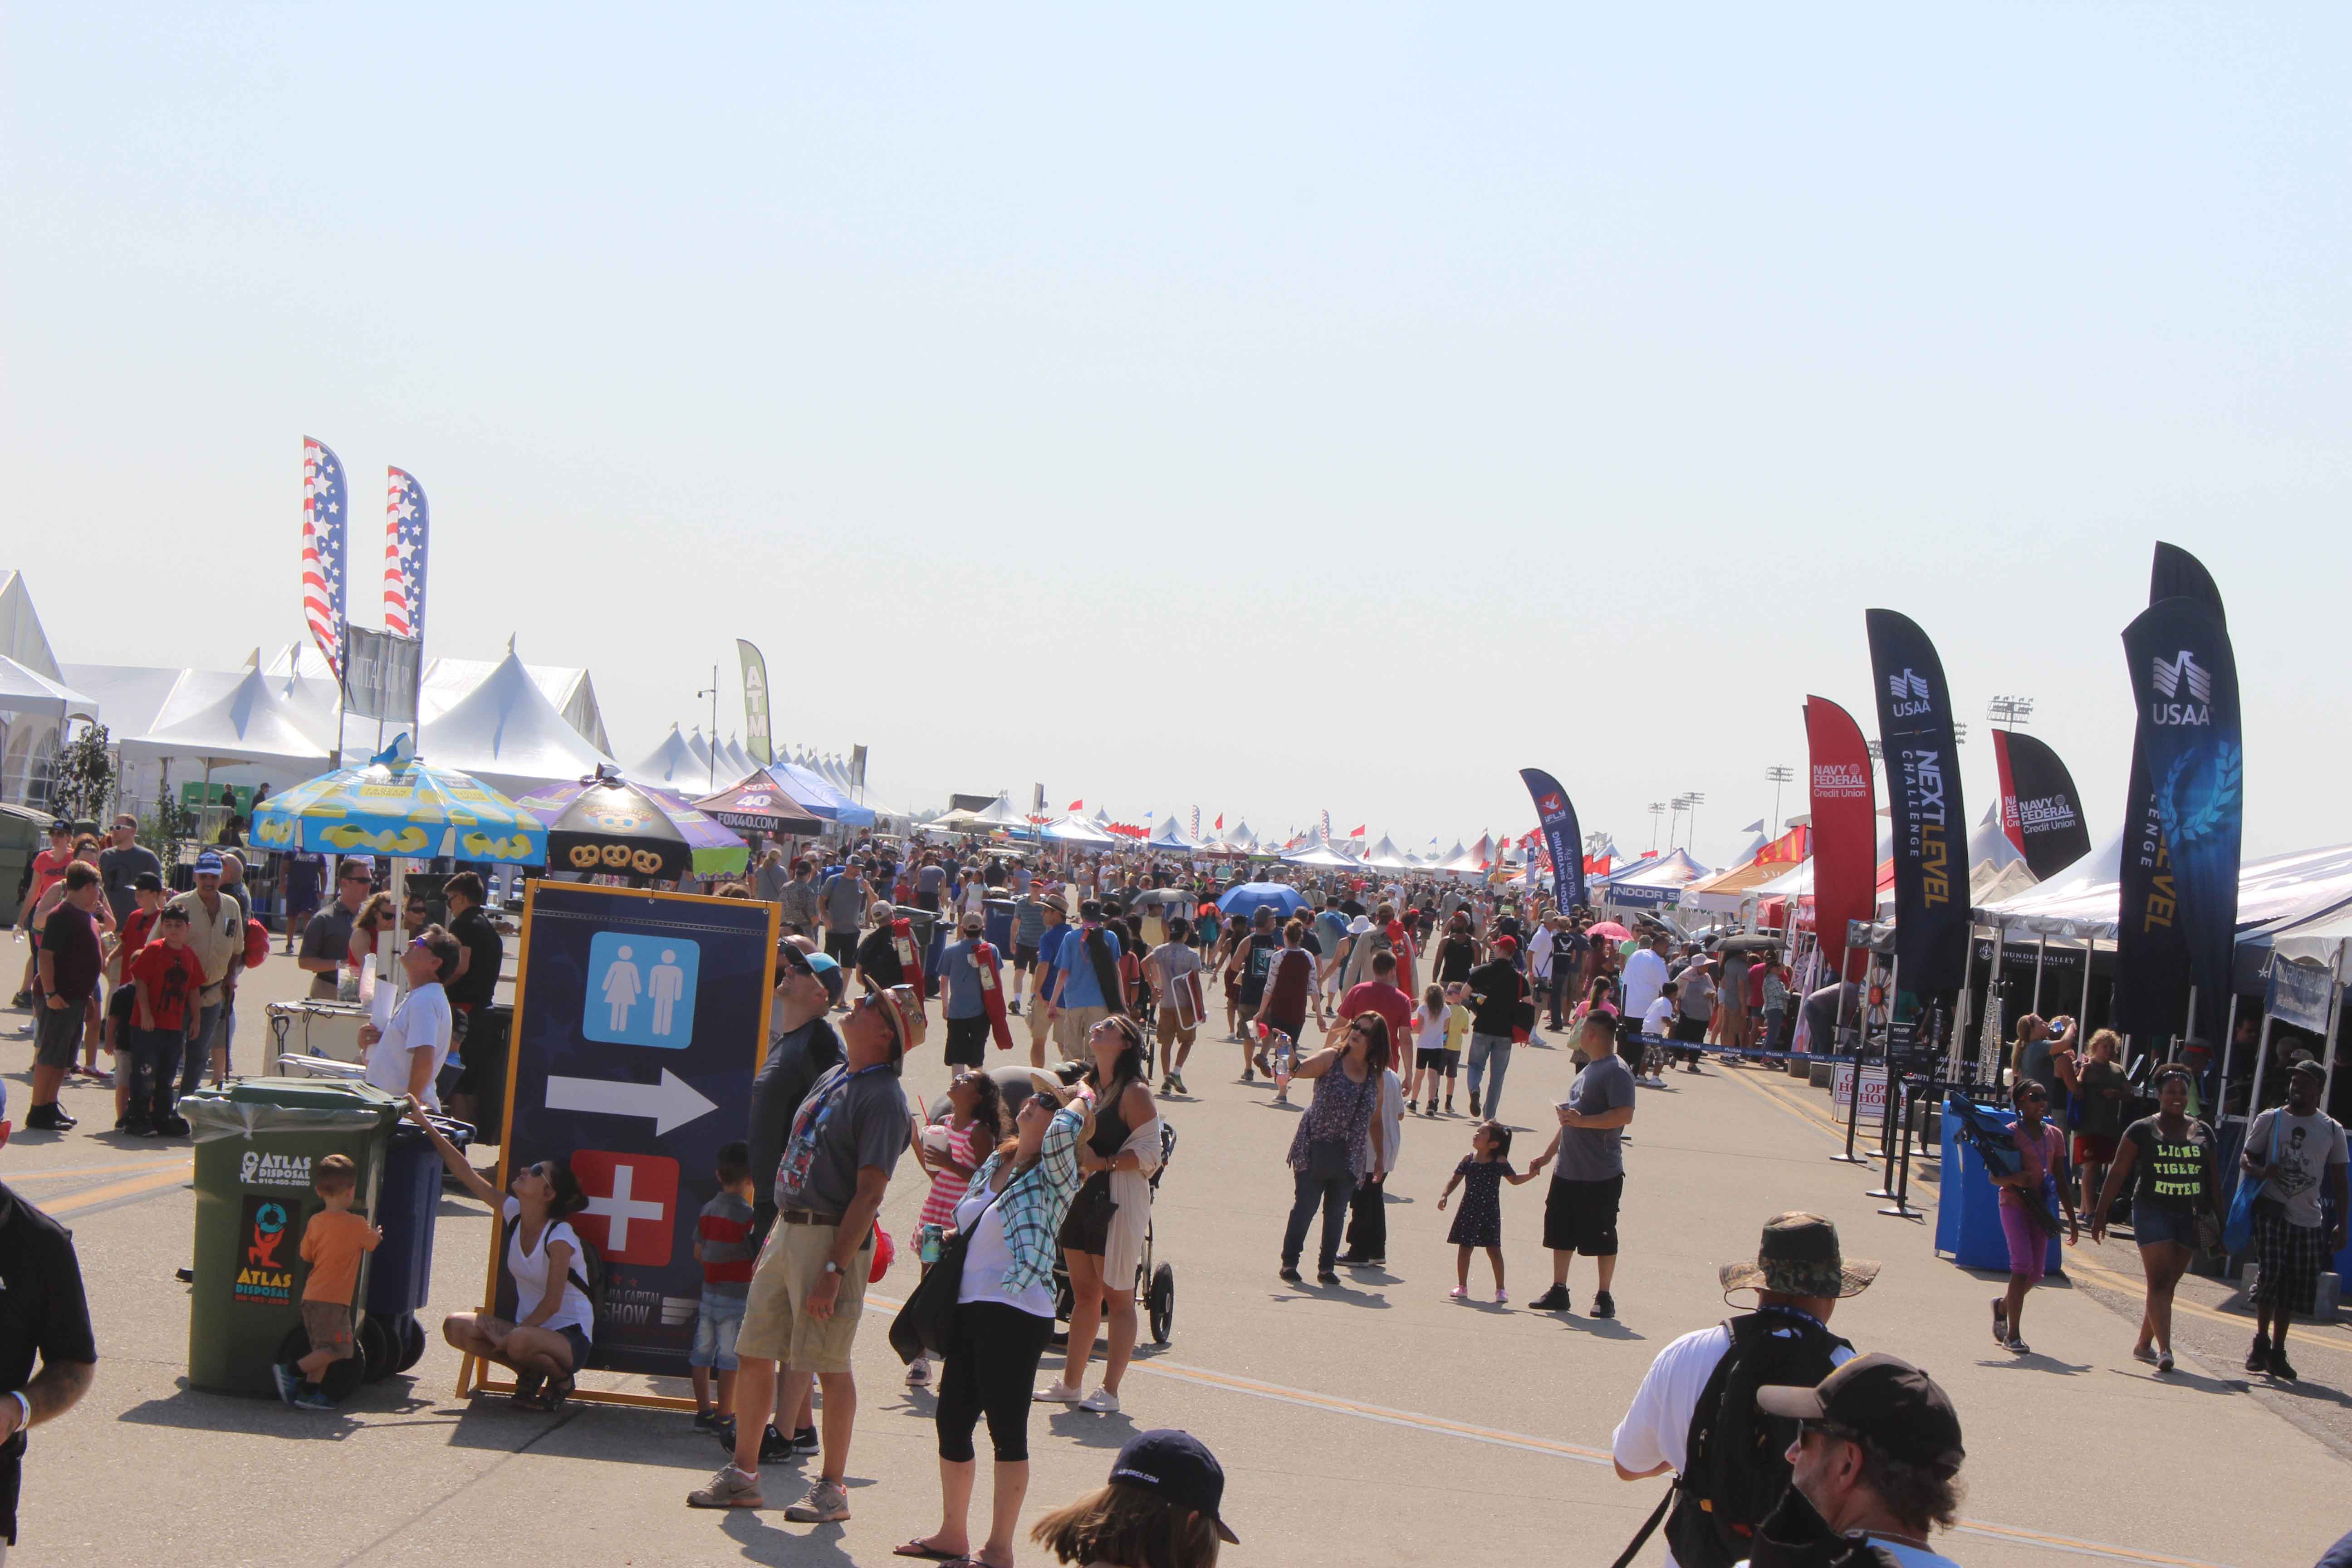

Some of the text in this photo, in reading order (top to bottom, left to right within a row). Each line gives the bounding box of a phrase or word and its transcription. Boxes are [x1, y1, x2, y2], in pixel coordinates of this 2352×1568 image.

[746, 665, 768, 737] ATM
[1893, 699, 1931, 717] USAA
[2153, 703, 2211, 726] USAA
[1813, 764, 1847, 775] NAVY
[1814, 774, 1866, 784] FEDERAL
[743, 783, 773, 792] FOX
[1814, 788, 1866, 798] Credit Union
[736, 794, 772, 807] 40
[1901, 750, 1920, 857] CHALLENGE
[2019, 797, 2053, 812] NAVY
[2020, 804, 2073, 822] FEDERAL
[717, 812, 779, 830] FOX40.COM
[2024, 819, 2076, 834] Credit Union
[1552, 830, 1566, 881] SKYDIVING
[1566, 862, 1574, 880] Can
[2143, 834, 2176, 933] EVEL
[1612, 886, 1663, 900] INDOOR
[2002, 951, 2040, 960] HUNDER
[2043, 955, 2076, 965] VALLEY
[1865, 1083, 1887, 1094] OP
[2157, 1145, 2201, 1158] LIONS
[260, 1152, 311, 1170] ATLAS
[259, 1168, 310, 1179] DISPOSAL
[2153, 1163, 2202, 1175] TIGERS
[2154, 1181, 2200, 1195] KITTENS
[236, 1267, 292, 1288] ATLAS
[235, 1284, 289, 1298] DISPOSAL
[624, 1290, 659, 1304] CAPITAL
[603, 1302, 650, 1325] SHOW
